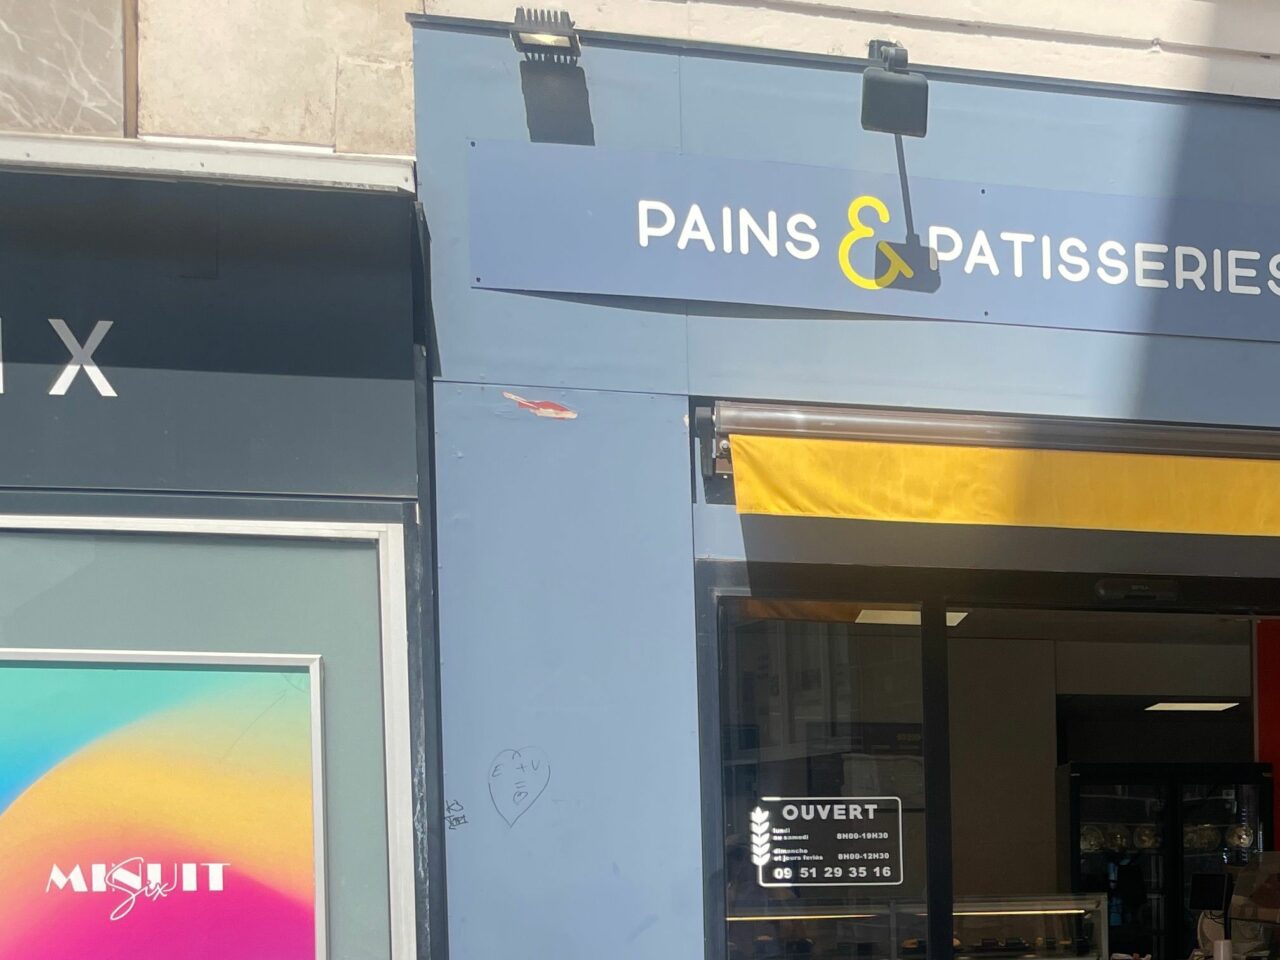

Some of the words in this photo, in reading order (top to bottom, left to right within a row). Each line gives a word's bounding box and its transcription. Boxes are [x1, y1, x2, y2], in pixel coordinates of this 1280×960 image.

[637, 200, 820, 260] PAINS
[838, 196, 914, 290] &
[0, 317, 118, 398] X
[782, 804, 878, 821] OUVERT
[836, 832, 889, 840] 8H00-19H30
[46, 863, 231, 893] MINUIT
[773, 867, 793, 879] 09
[800, 867, 817, 878] 51
[824, 867, 843, 878] 29
[848, 866, 867, 877] 35
[873, 866, 891, 877] 16
[105, 857, 168, 921] Six
